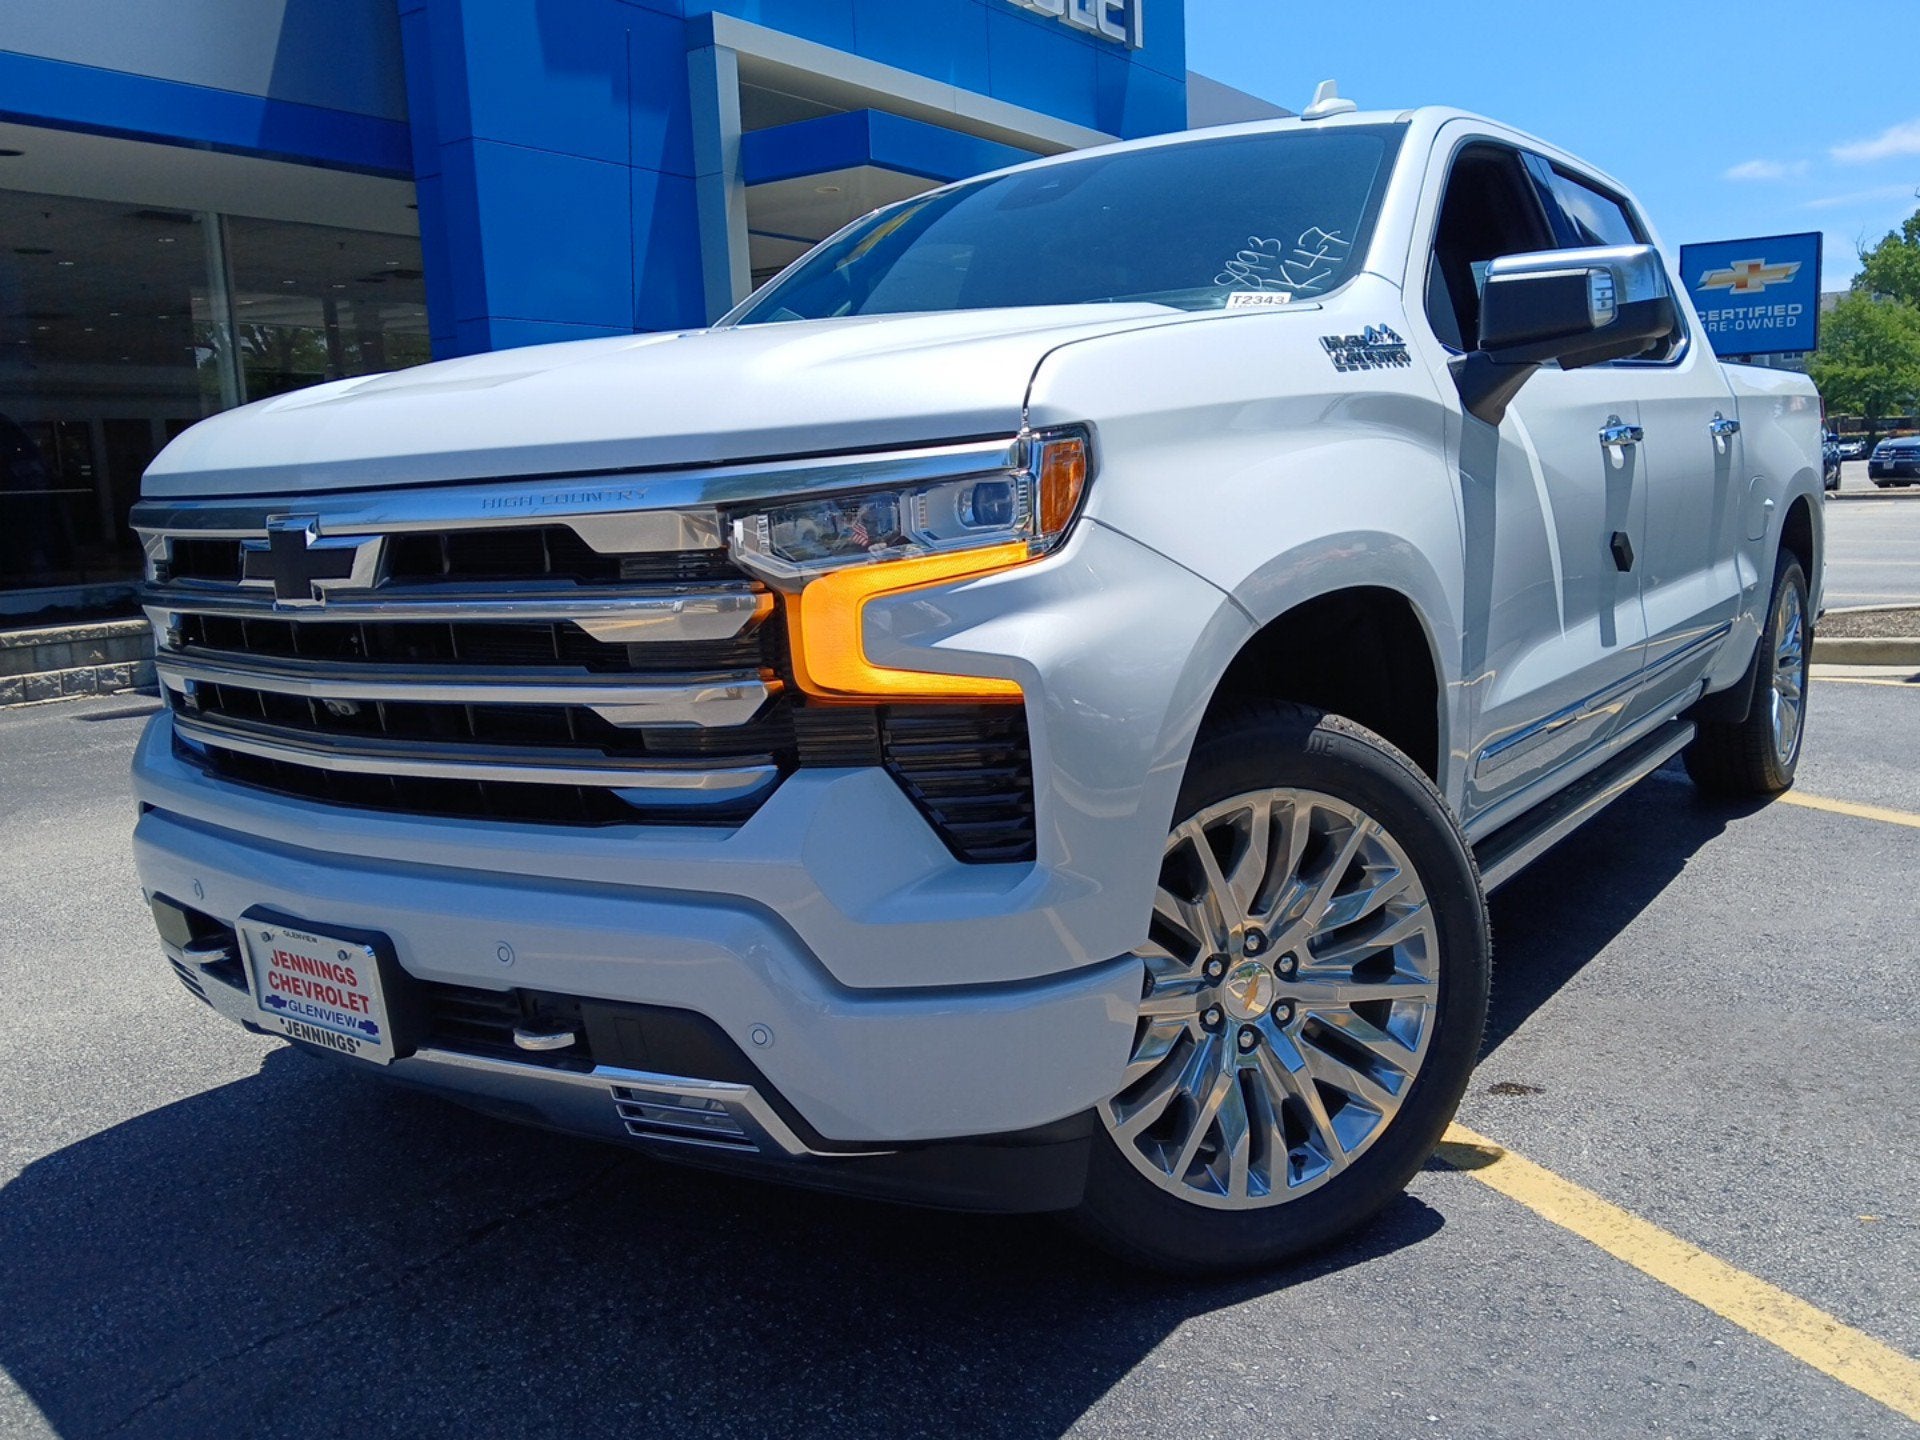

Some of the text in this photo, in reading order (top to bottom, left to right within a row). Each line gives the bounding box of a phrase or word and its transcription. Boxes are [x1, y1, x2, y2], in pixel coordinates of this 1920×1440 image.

[1214, 236, 1281, 289] 8993
[1232, 295, 1286, 305] T2343
[1697, 303, 1803, 322] CERTIFIED
[482, 488, 648, 509] HIGH COUNTRY
[270, 949, 358, 987] JENNINGS
[267, 970, 369, 1014] CHEVROLET
[288, 999, 358, 1029] GLENVIEW
